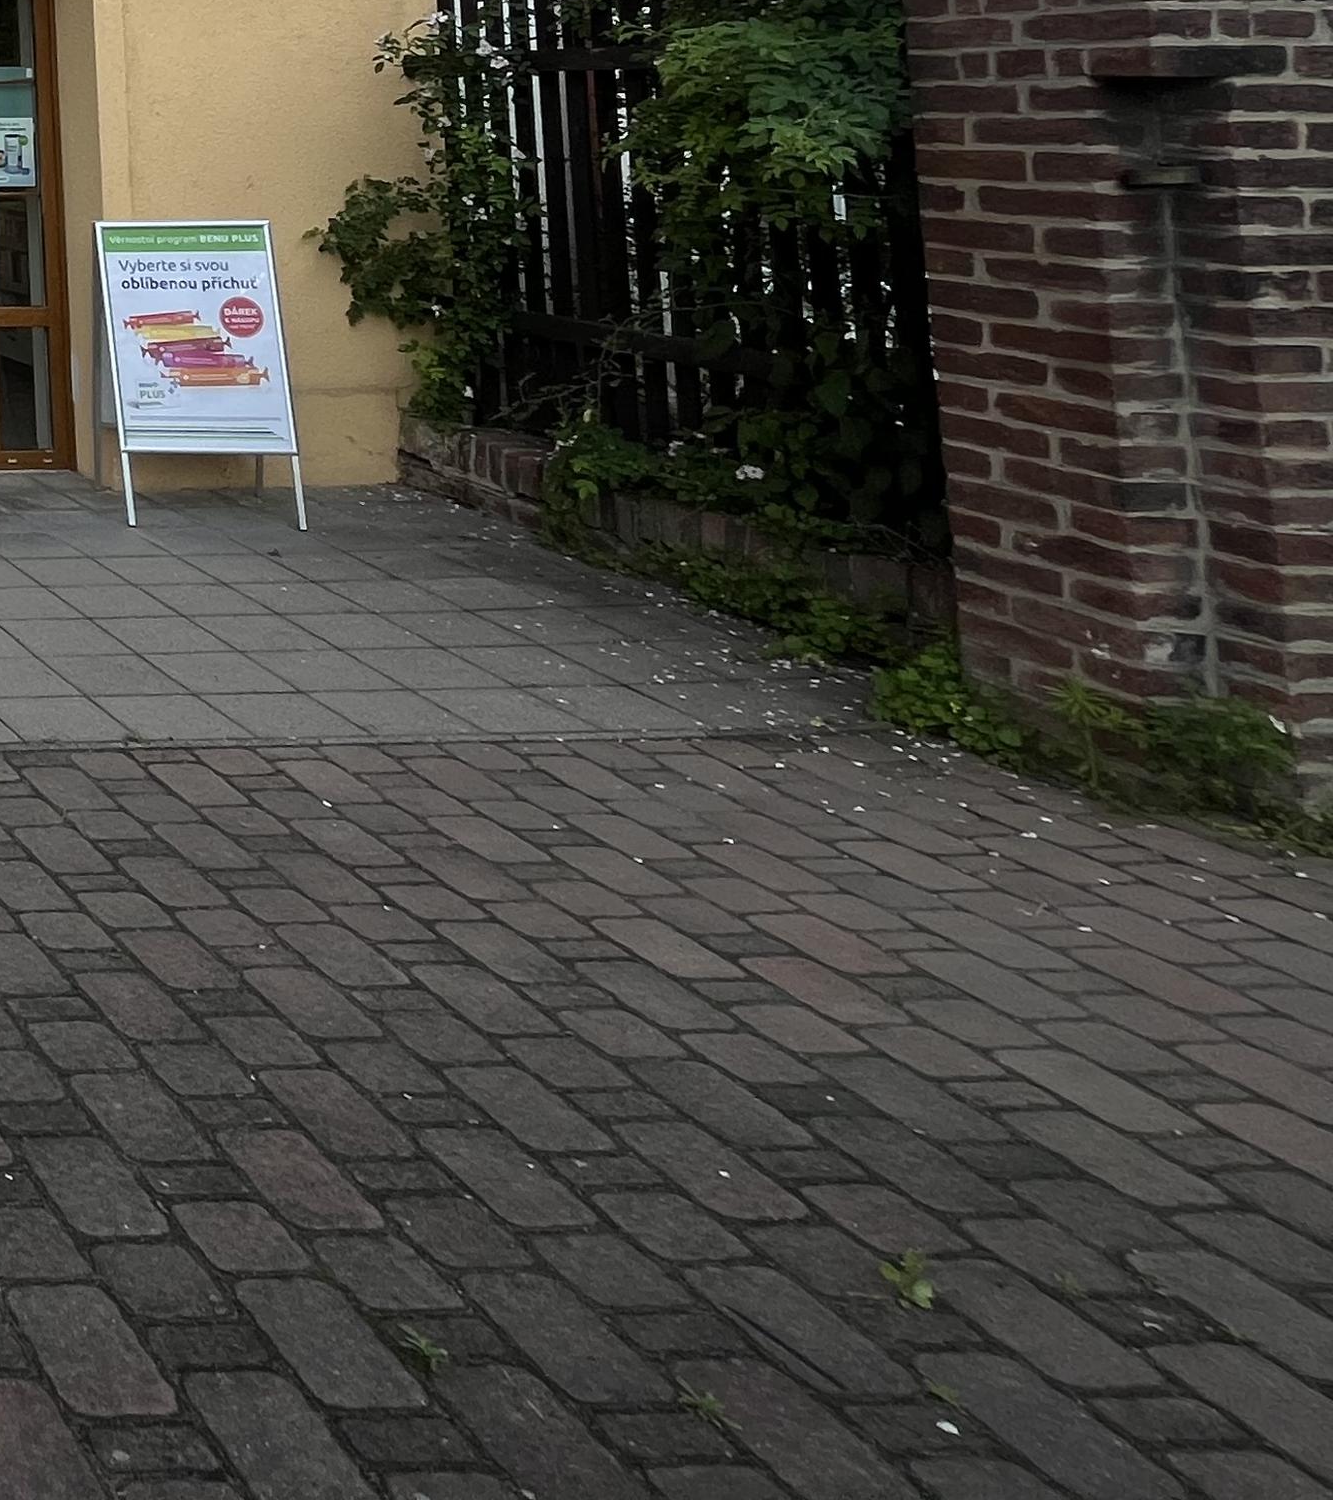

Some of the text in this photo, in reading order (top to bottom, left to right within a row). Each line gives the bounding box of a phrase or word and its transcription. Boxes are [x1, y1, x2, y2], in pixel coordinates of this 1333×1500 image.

[199, 234, 229, 243] BENU
[231, 233, 259, 243] PLUS
[118, 258, 229, 274] Vyberte si svou
[121, 276, 197, 290] oblíbenou
